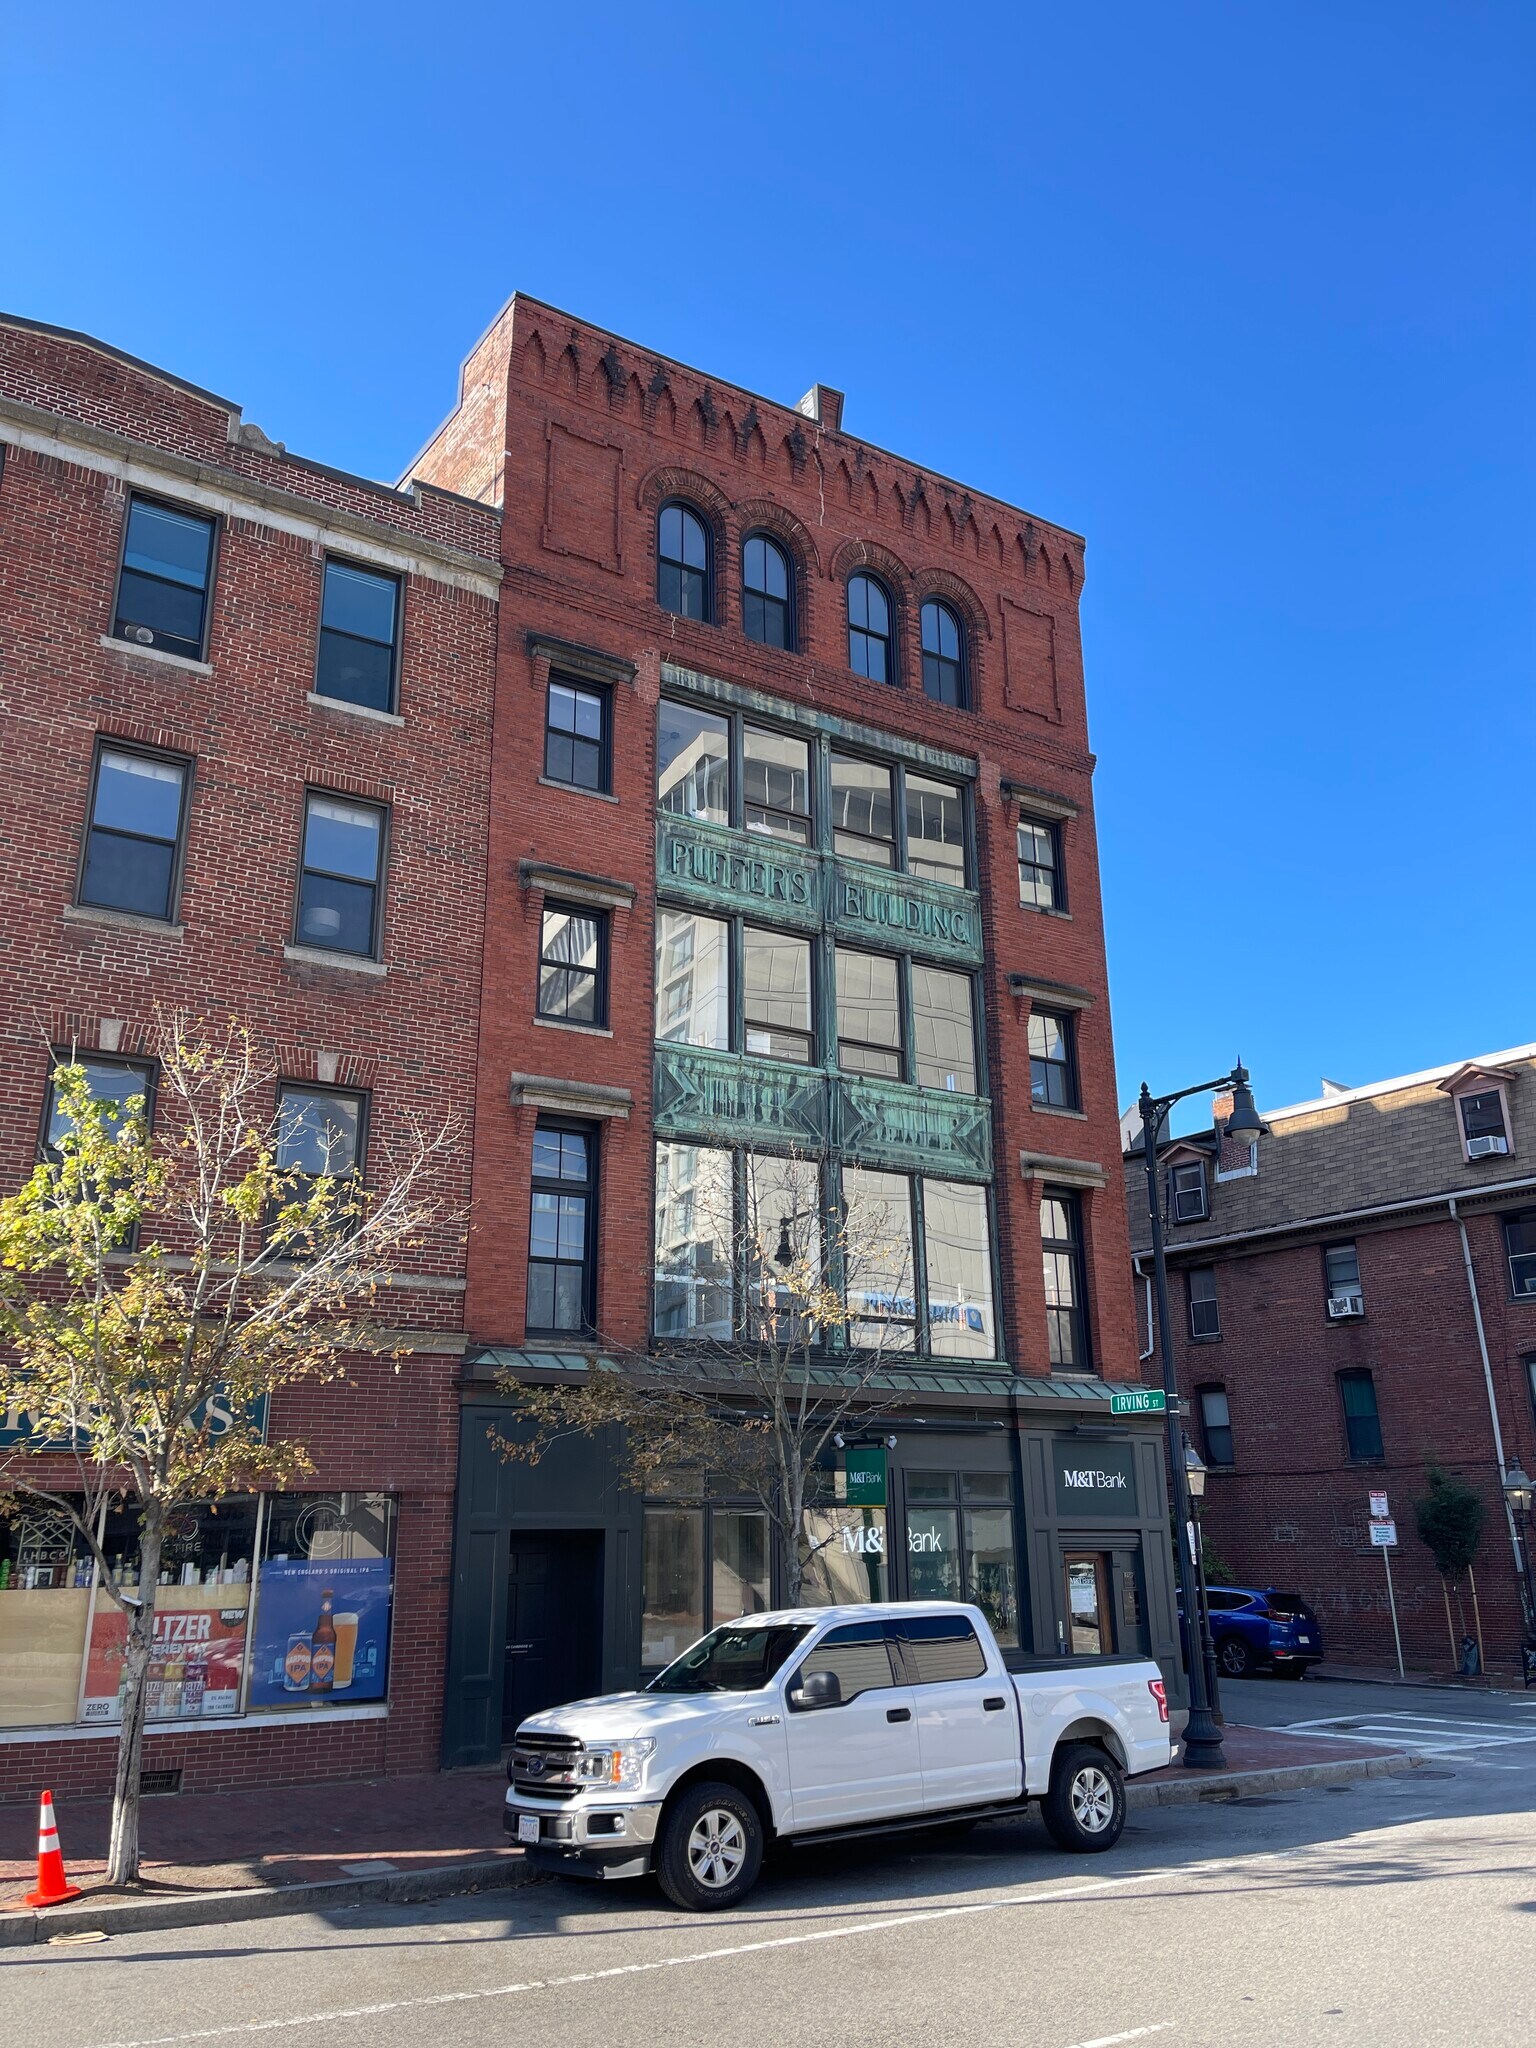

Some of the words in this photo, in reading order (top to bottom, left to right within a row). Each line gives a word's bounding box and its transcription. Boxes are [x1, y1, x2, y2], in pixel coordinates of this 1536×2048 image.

[1116, 1394, 1150, 1411] IRVING
[1152, 1399, 1159, 1408] ST
[849, 1471, 866, 1484] M&T
[866, 1471, 883, 1484] Bank
[1063, 1469, 1096, 1488] M&T
[1096, 1470, 1127, 1489] Bank
[841, 1525, 884, 1554] M&
[359, 1566, 370, 1574] IPA
[220, 1609, 246, 1620] NEW
[127, 1614, 212, 1642] LTZER
[290, 1664, 307, 1673] IPA
[86, 1703, 110, 1711] ZERO
